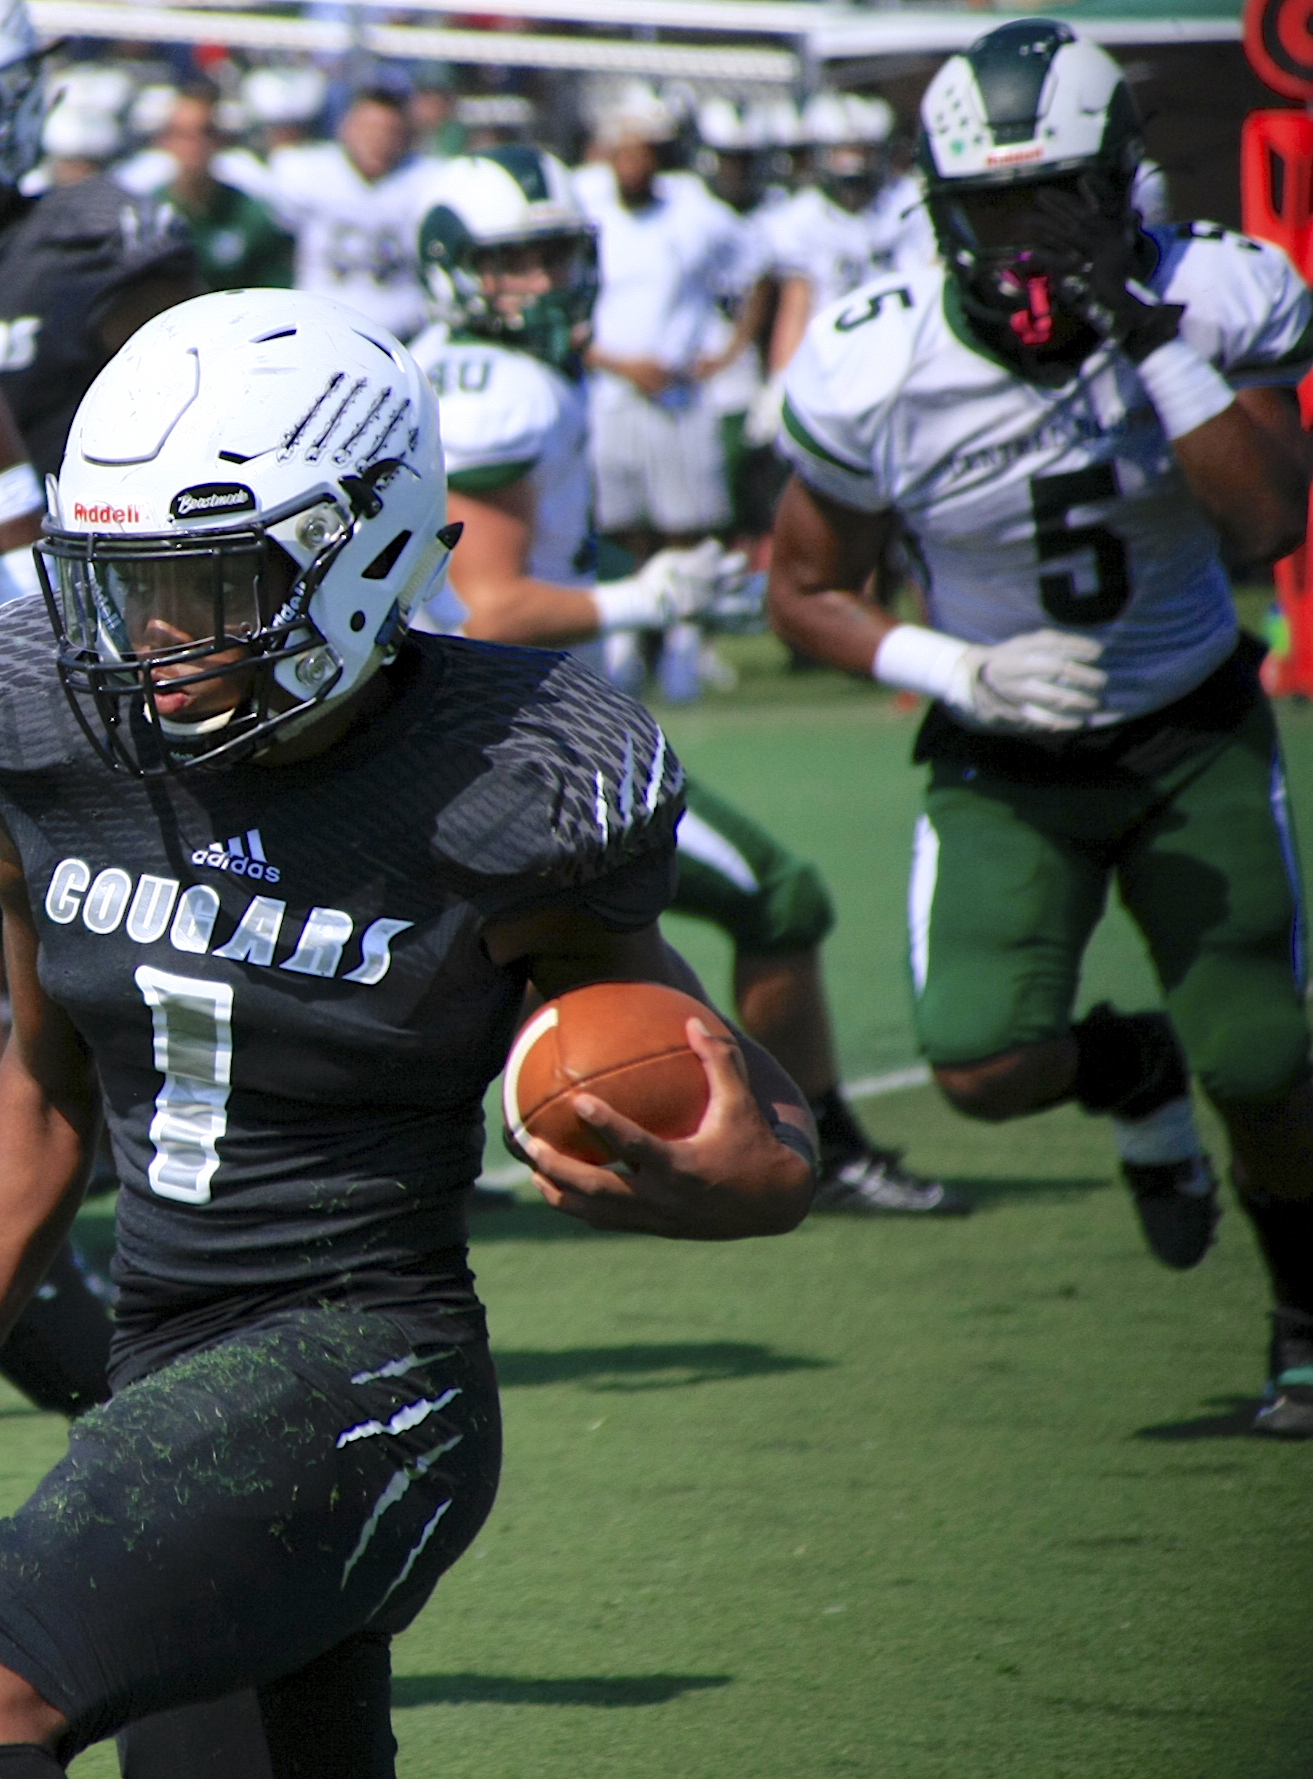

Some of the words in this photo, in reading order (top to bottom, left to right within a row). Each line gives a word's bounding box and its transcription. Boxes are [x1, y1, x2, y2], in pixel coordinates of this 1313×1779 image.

[834, 286, 914, 333] 5
[74, 502, 140, 524] Riddell
[177, 488, 250, 515] Beastmode
[1031, 460, 1132, 628] 5
[191, 848, 281, 883] adidas
[45, 858, 415, 985] COUGARS
